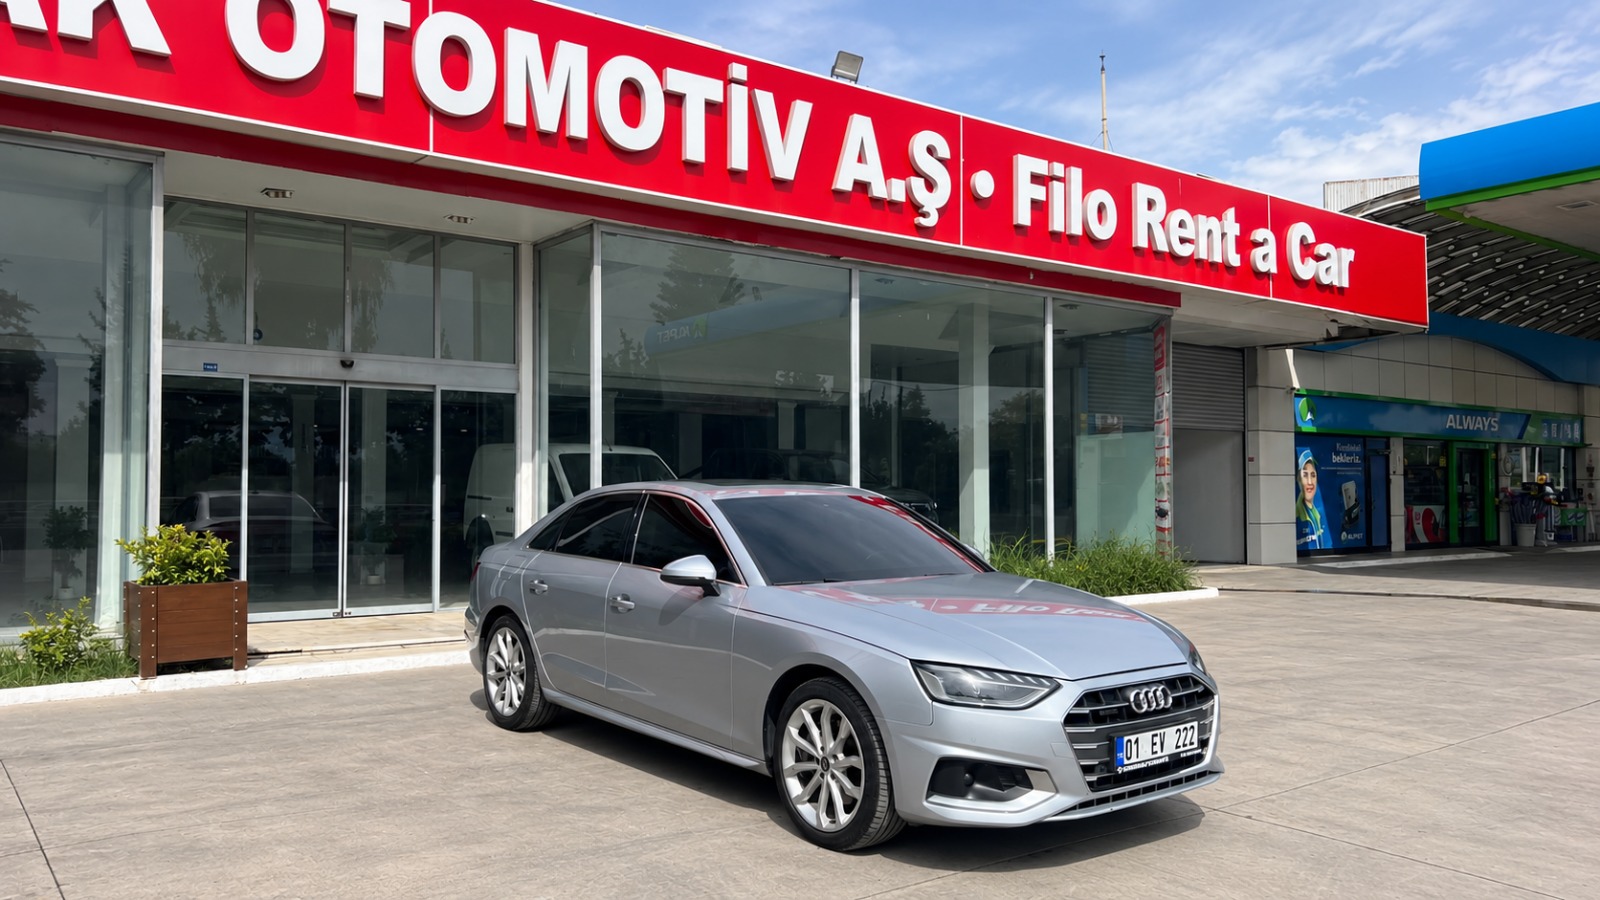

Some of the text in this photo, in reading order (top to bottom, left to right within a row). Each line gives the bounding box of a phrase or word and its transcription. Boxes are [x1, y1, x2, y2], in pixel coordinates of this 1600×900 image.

[224, 0, 814, 181] OTOMOTİV
[831, 113, 952, 229] A.Ş
[1012, 153, 1118, 241] Filo
[1131, 181, 1241, 267] Rent
[1250, 227, 1278, 275] a
[1286, 221, 1356, 288] Car
[1446, 414, 1499, 432] ALWAYS
[1125, 725, 1196, 761] 01 EV 222
